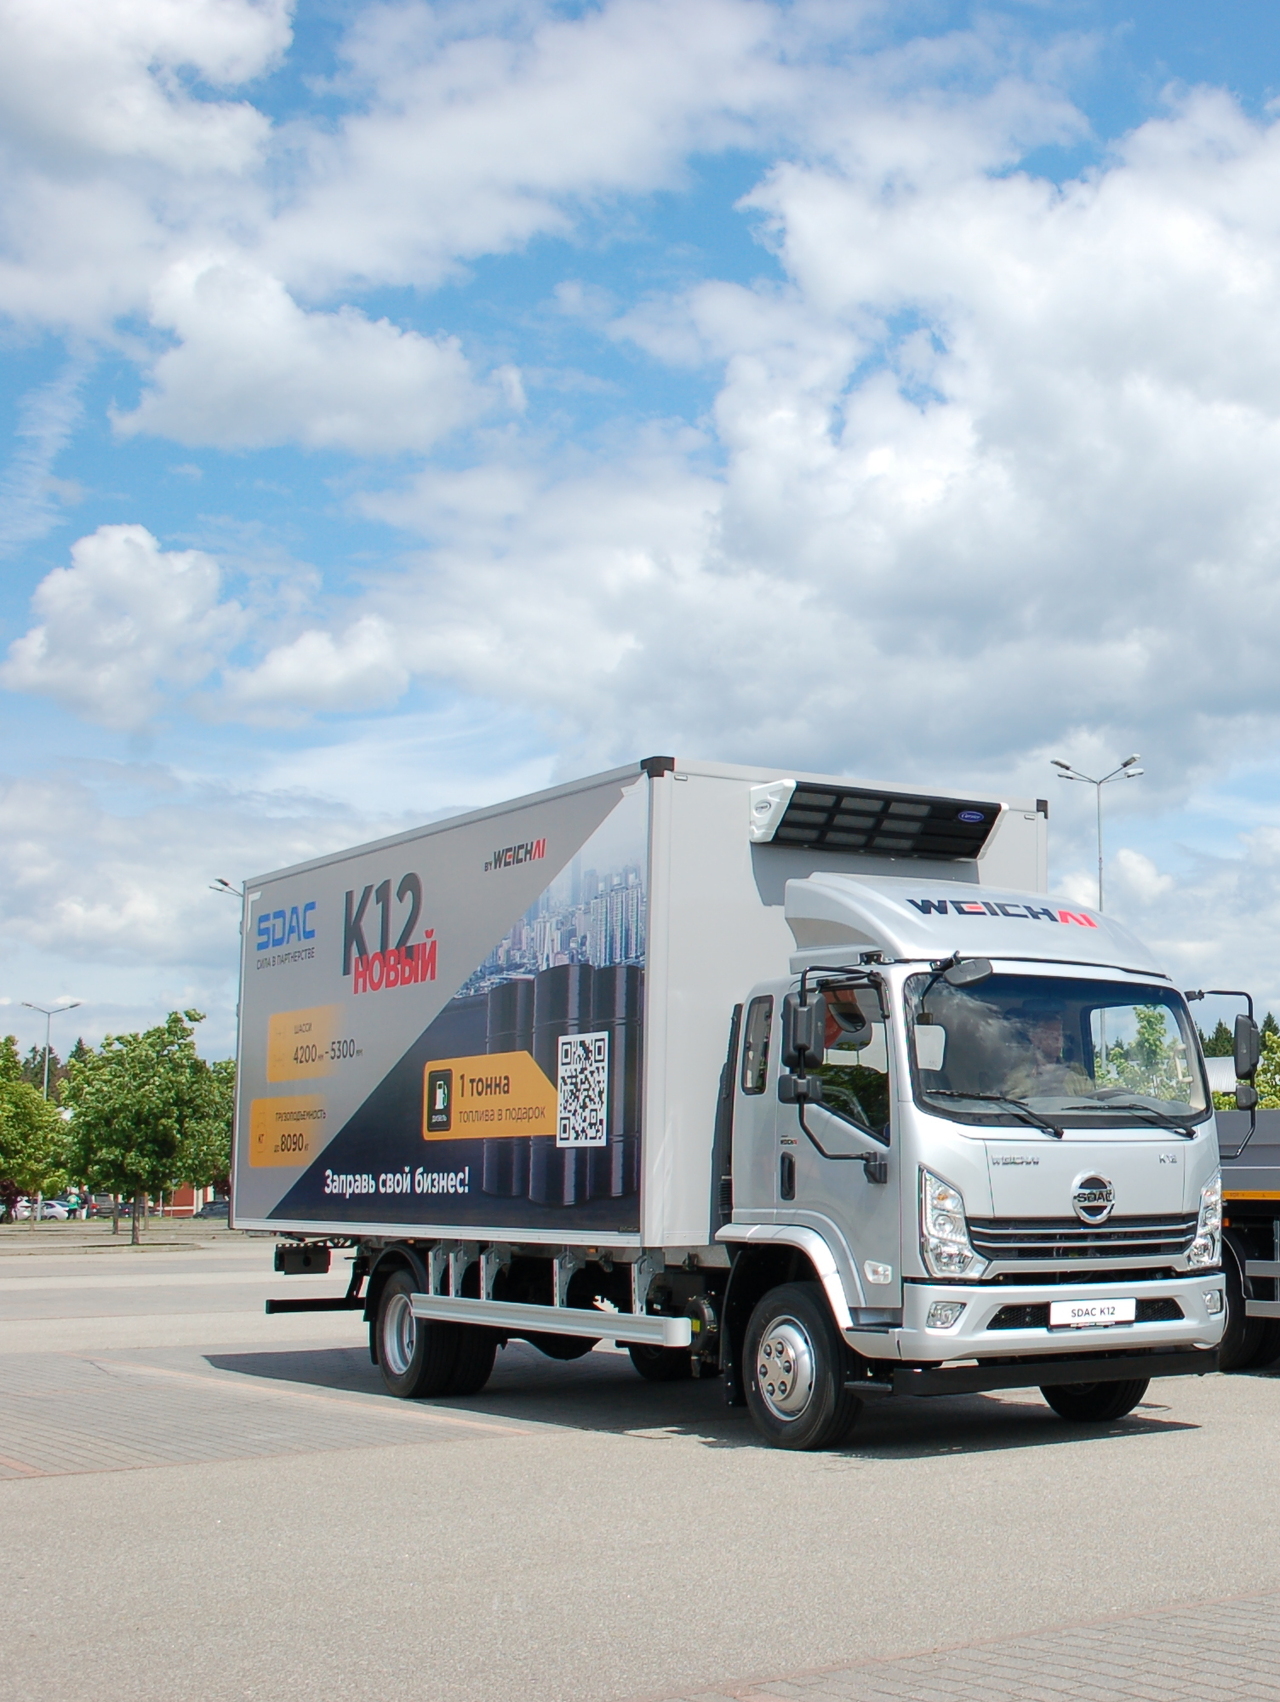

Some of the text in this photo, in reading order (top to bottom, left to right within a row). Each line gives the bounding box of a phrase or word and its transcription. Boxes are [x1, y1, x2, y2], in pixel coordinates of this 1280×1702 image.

[485, 838, 546, 872] BY WEICHAI
[256, 901, 316, 951] SDAC
[342, 872, 423, 976] K12
[905, 899, 1098, 928] WEICHAI
[353, 928, 437, 995] НОВЫЙ
[460, 1073, 510, 1097] 1 тонна
[459, 1106, 545, 1123] топлива в подарок
[281, 1133, 304, 1152] 8090
[324, 1166, 469, 1199] Заправь свой бизнес!
[1076, 1190, 1112, 1202] SDAC
[1071, 1306, 1116, 1318] SDAC K12
